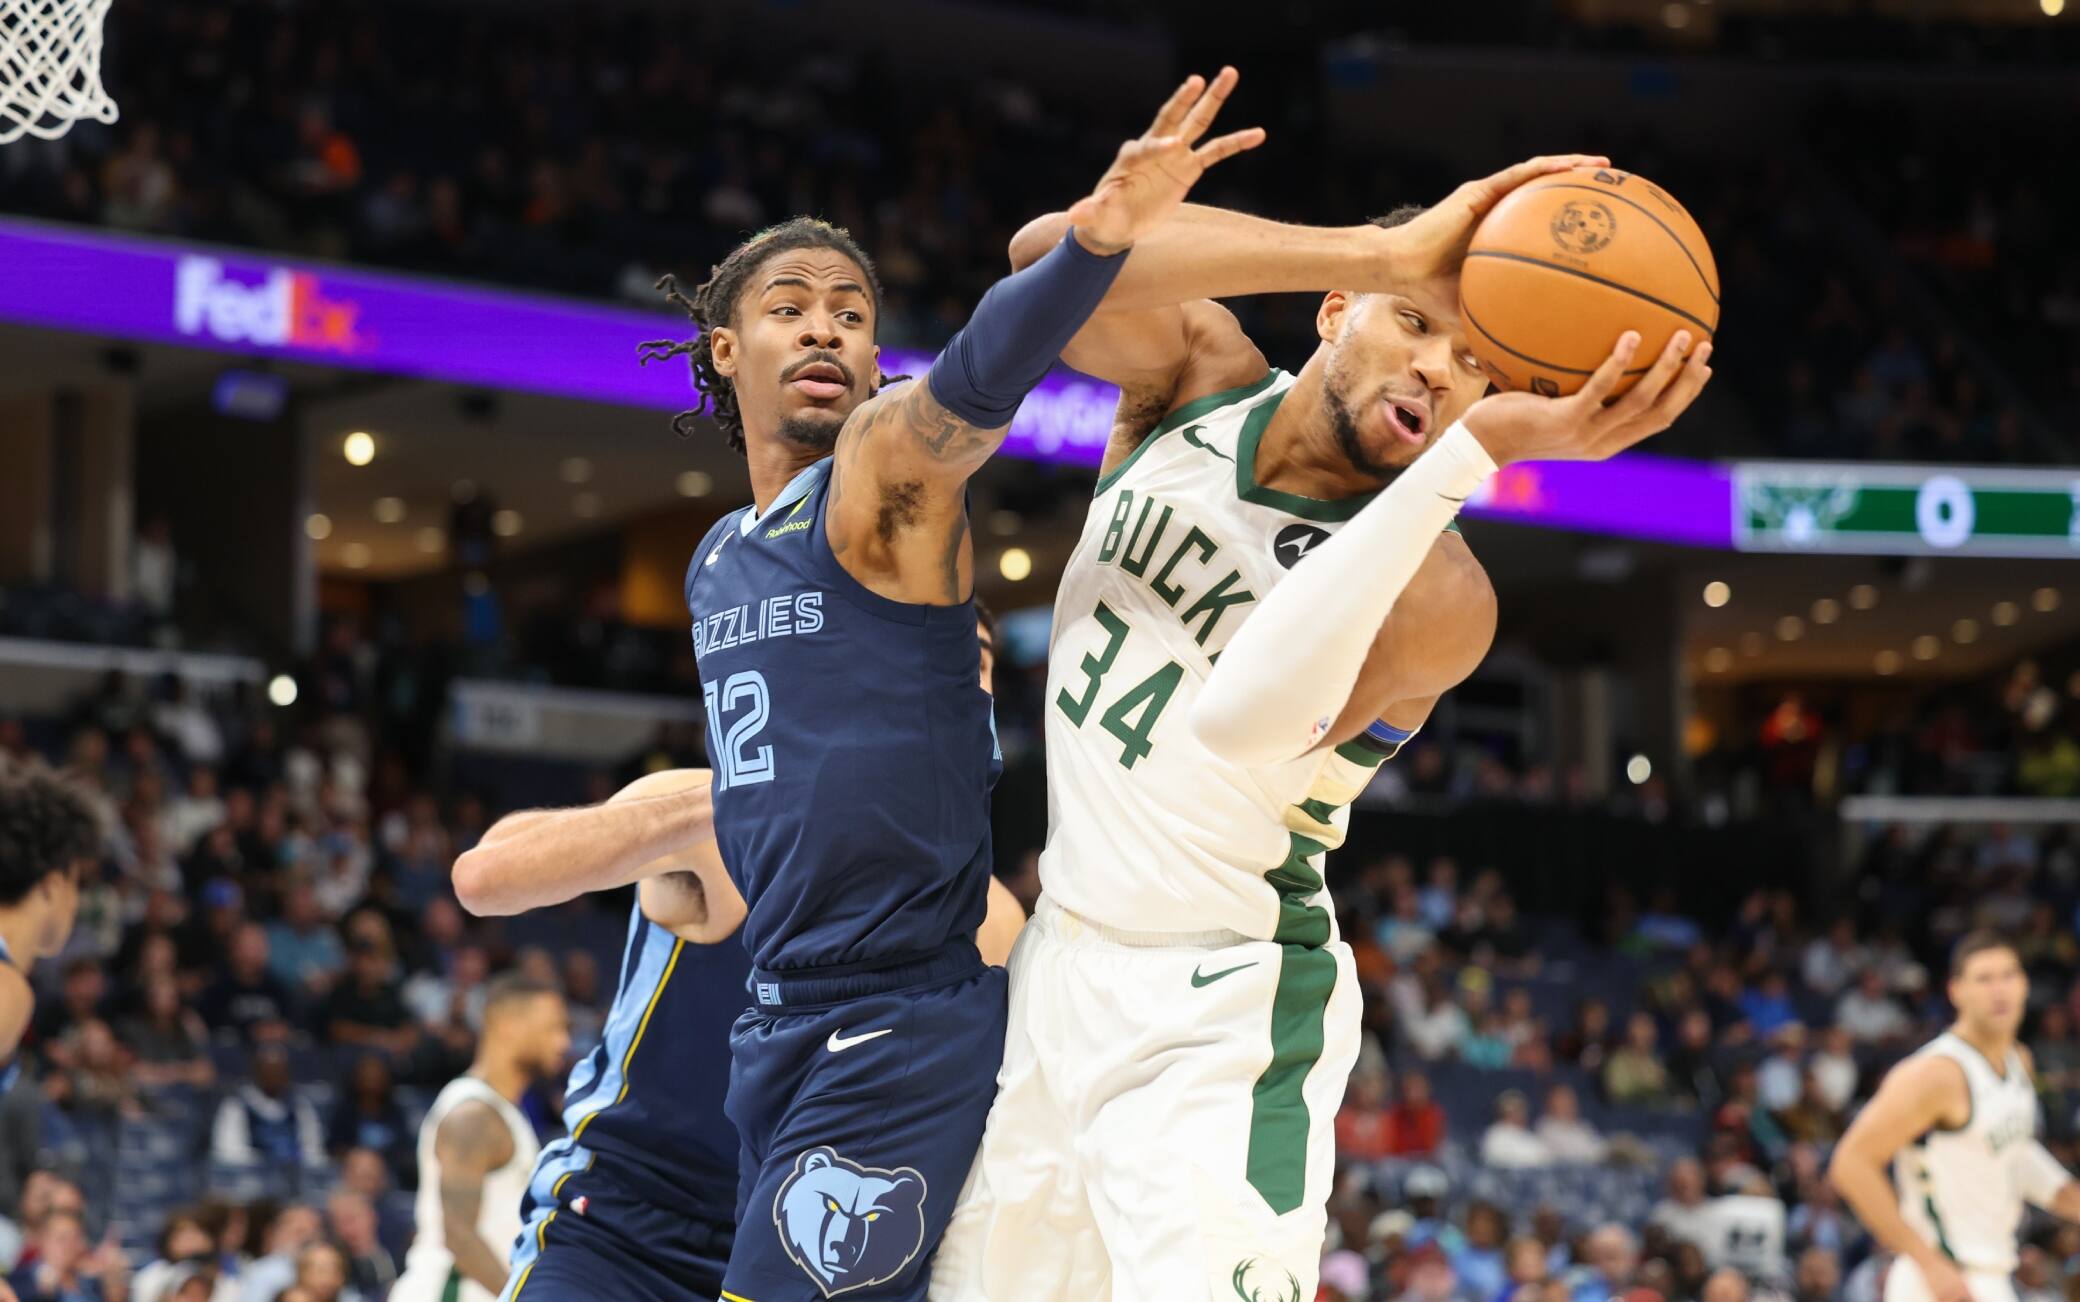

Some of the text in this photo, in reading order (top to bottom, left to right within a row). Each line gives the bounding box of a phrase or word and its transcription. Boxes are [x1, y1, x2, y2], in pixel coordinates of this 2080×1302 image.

[175, 256, 362, 350] FedEx
[1916, 474, 1975, 548] 0
[691, 591, 825, 663] RIZZLIES
[1096, 488, 1258, 667] BUCK
[703, 669, 776, 792] 12
[1055, 598, 1186, 771] 34
